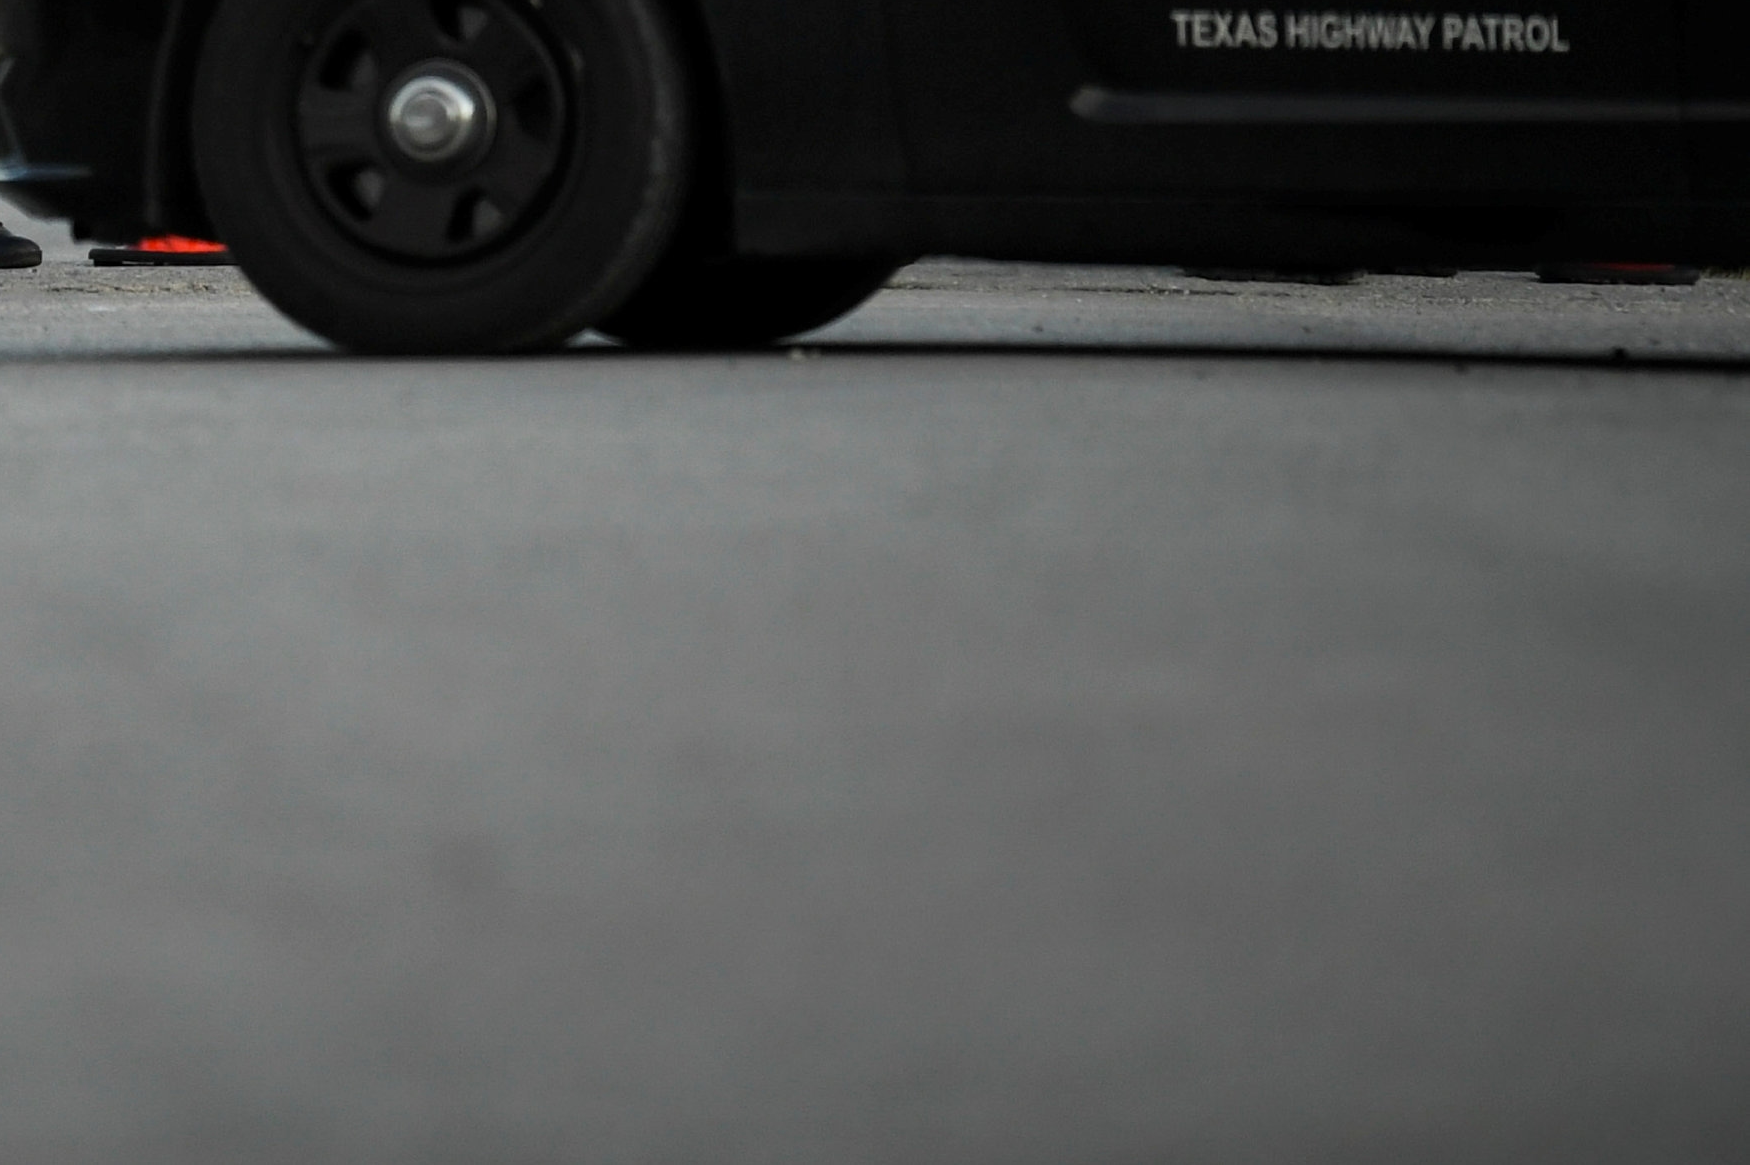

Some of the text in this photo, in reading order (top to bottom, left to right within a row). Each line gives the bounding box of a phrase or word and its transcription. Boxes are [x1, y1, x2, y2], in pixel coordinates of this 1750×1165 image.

[1171, 9, 1571, 53] TEXAS HIGHWAY PATROL
